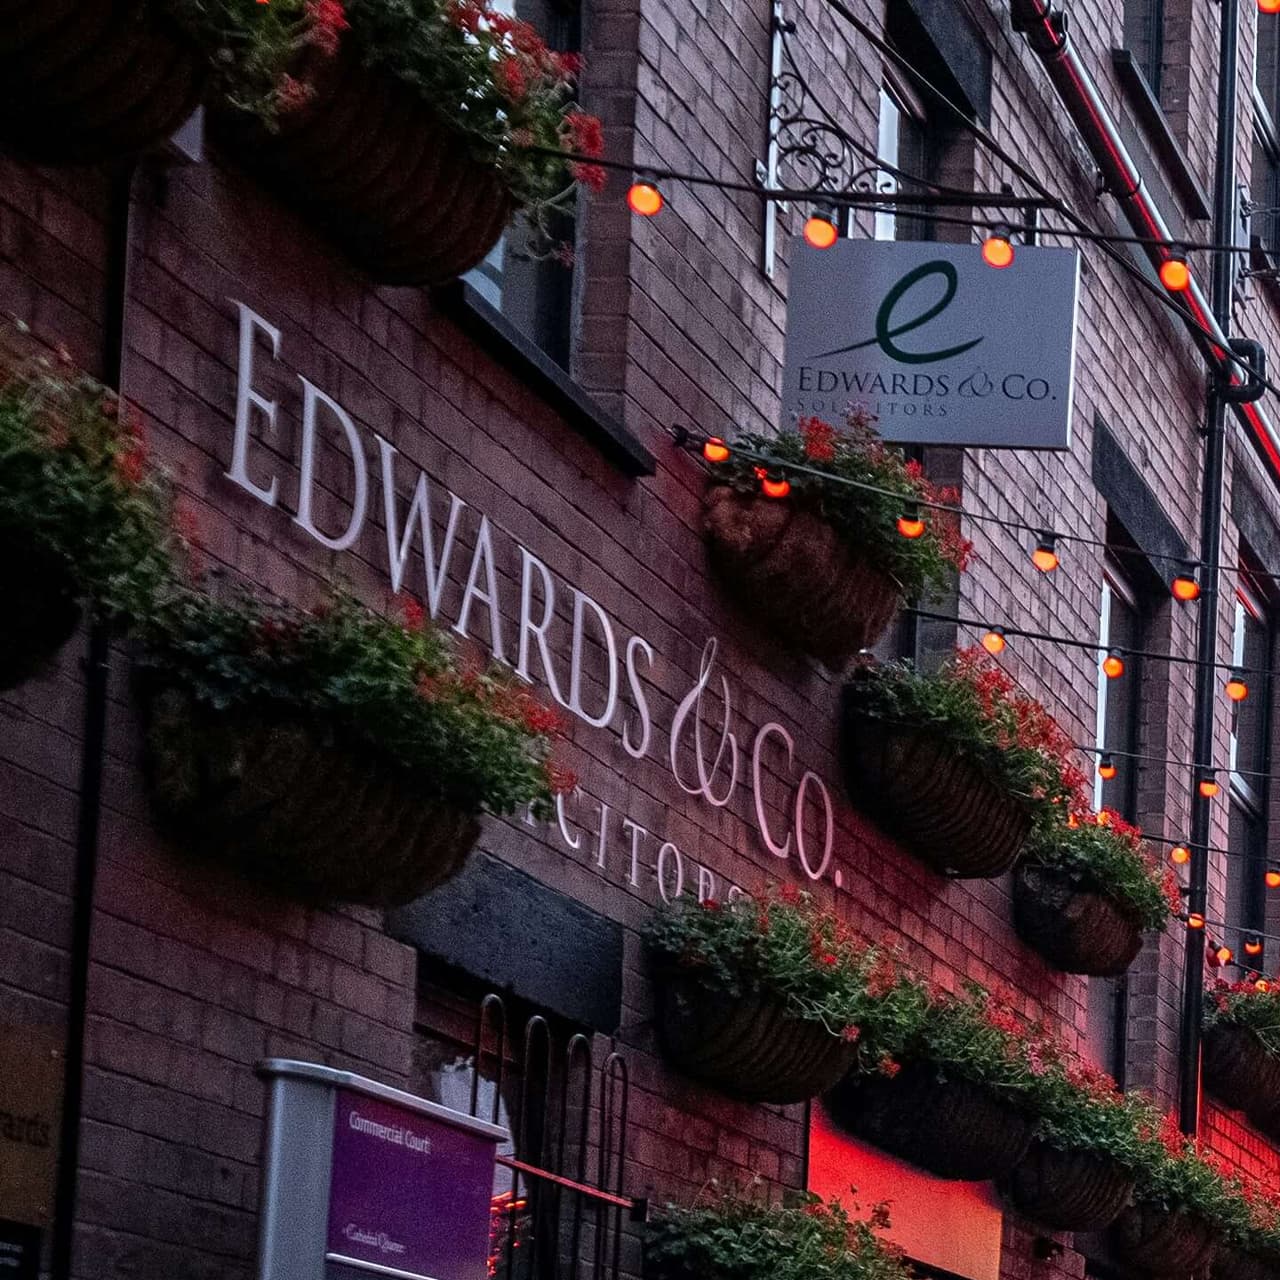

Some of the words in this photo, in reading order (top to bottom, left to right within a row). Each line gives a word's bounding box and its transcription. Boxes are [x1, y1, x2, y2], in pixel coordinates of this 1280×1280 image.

[798, 366, 950, 397] EDWARDS
[797, 399, 948, 418] SOLITORS
[225, 298, 655, 759] EDWARDS
[669, 636, 739, 808] &
[348, 1111, 403, 1146] Commercial
[404, 1129, 431, 1154] Court
